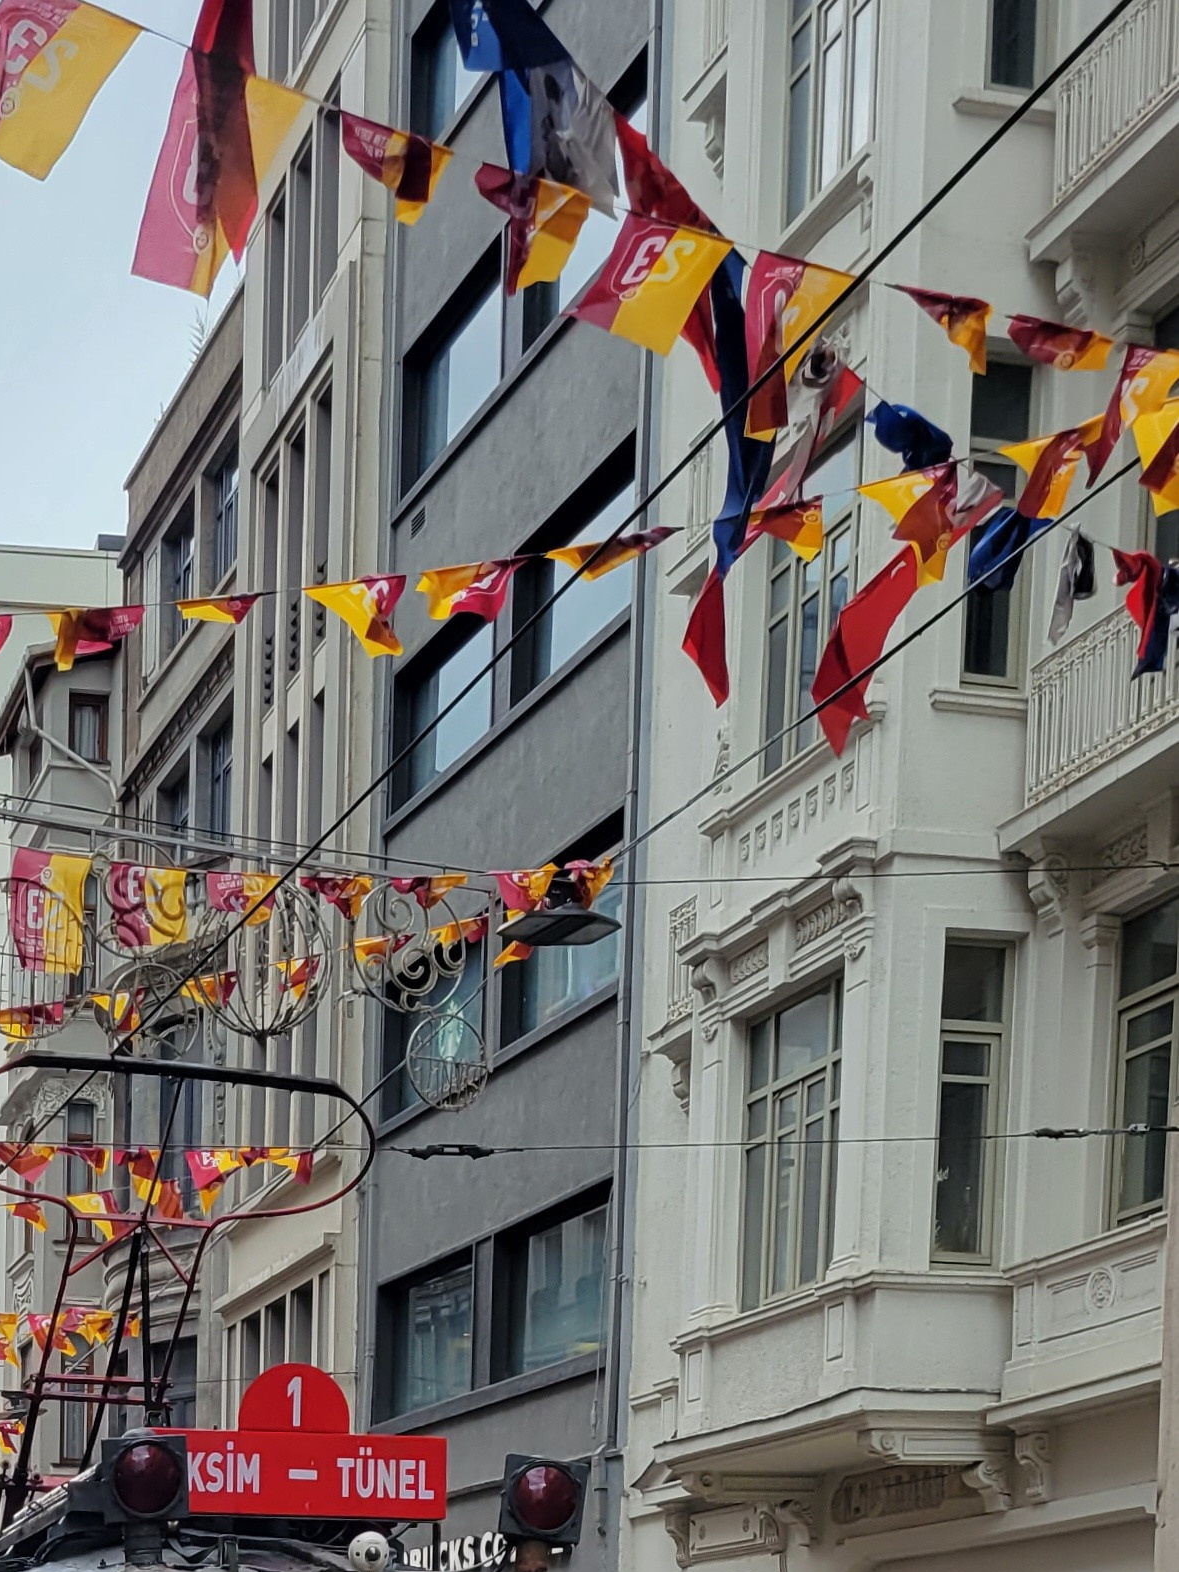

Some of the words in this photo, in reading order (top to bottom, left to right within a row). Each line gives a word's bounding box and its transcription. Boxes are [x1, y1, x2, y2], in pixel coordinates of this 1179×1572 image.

[287, 1376, 302, 1427] 1
[188, 1441, 260, 1494] KSİM
[336, 1447, 435, 1500] TÜNEL
